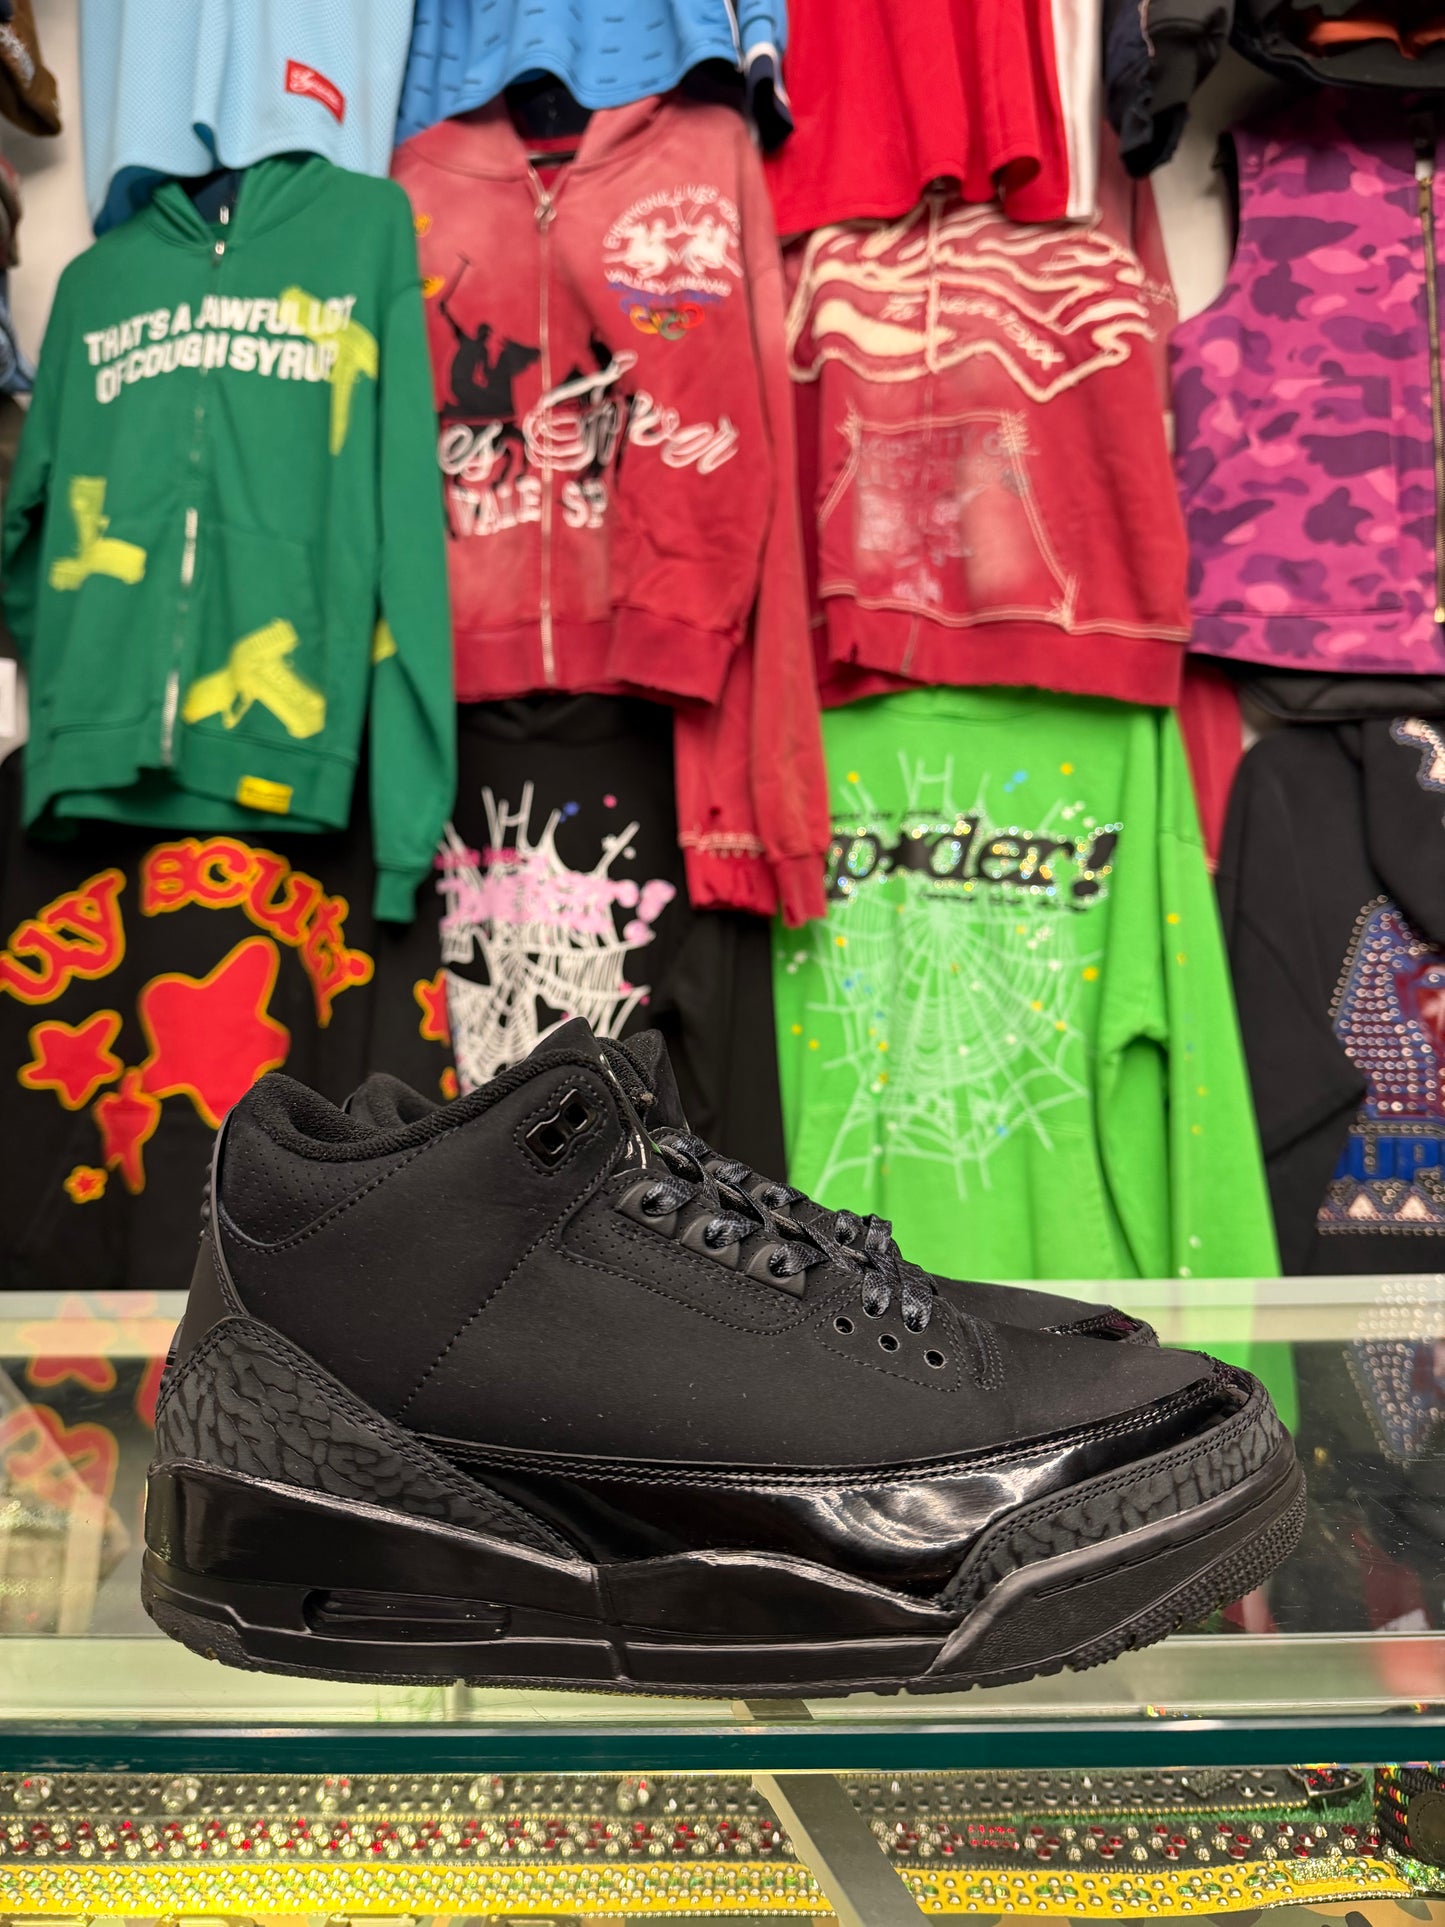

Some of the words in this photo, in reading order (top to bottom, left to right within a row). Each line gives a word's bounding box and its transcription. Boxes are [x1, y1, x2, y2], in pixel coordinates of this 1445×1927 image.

[84, 308, 171, 366] THAT'S
[170, 302, 192, 335] A
[194, 294, 306, 336] AWFUL
[123, 330, 231, 384] COUGH
[228, 334, 340, 383] SYRUP
